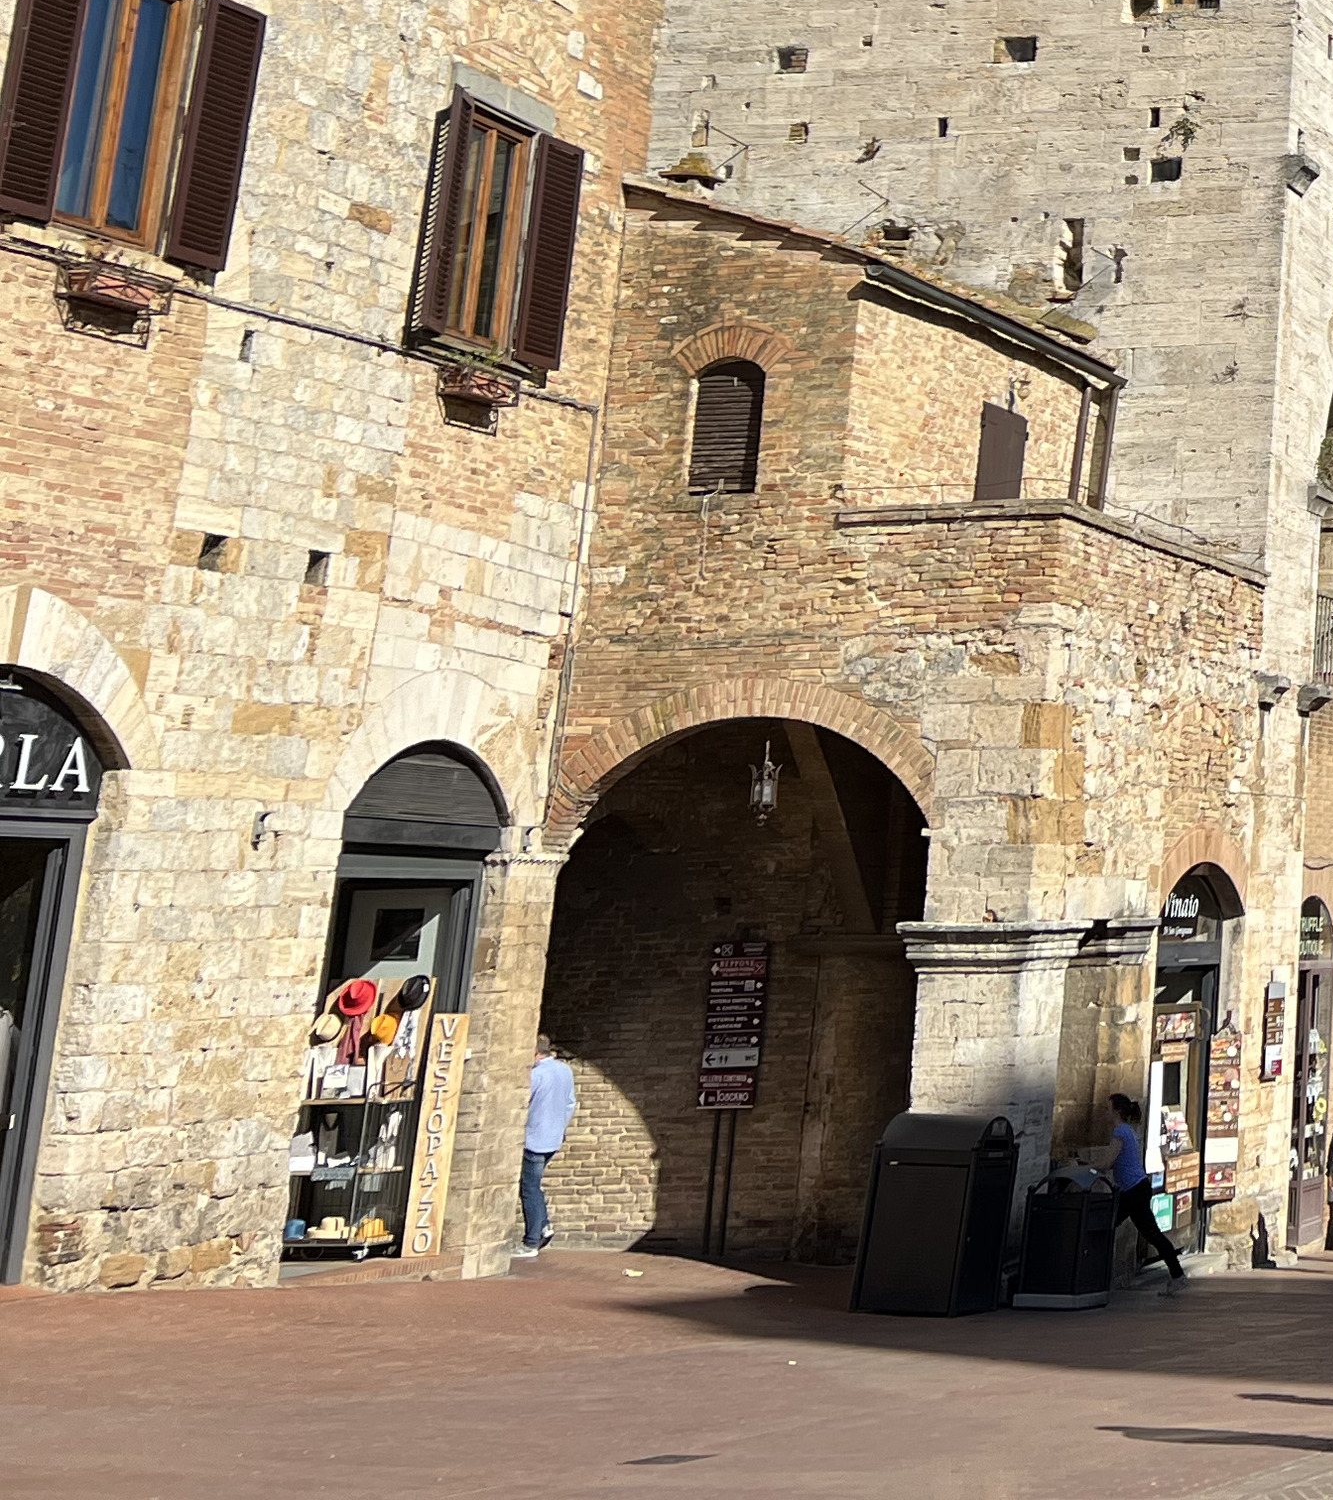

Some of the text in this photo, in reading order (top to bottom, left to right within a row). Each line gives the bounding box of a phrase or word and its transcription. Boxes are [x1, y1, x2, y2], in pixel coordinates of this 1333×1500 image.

[0, 733, 90, 792] LA
[1164, 892, 1199, 918] Vinaio
[1301, 917, 1323, 932] RUFFLE
[1299, 940, 1324, 955] OUTIQUE
[411, 1018, 459, 1253] VESTOPAZZO
